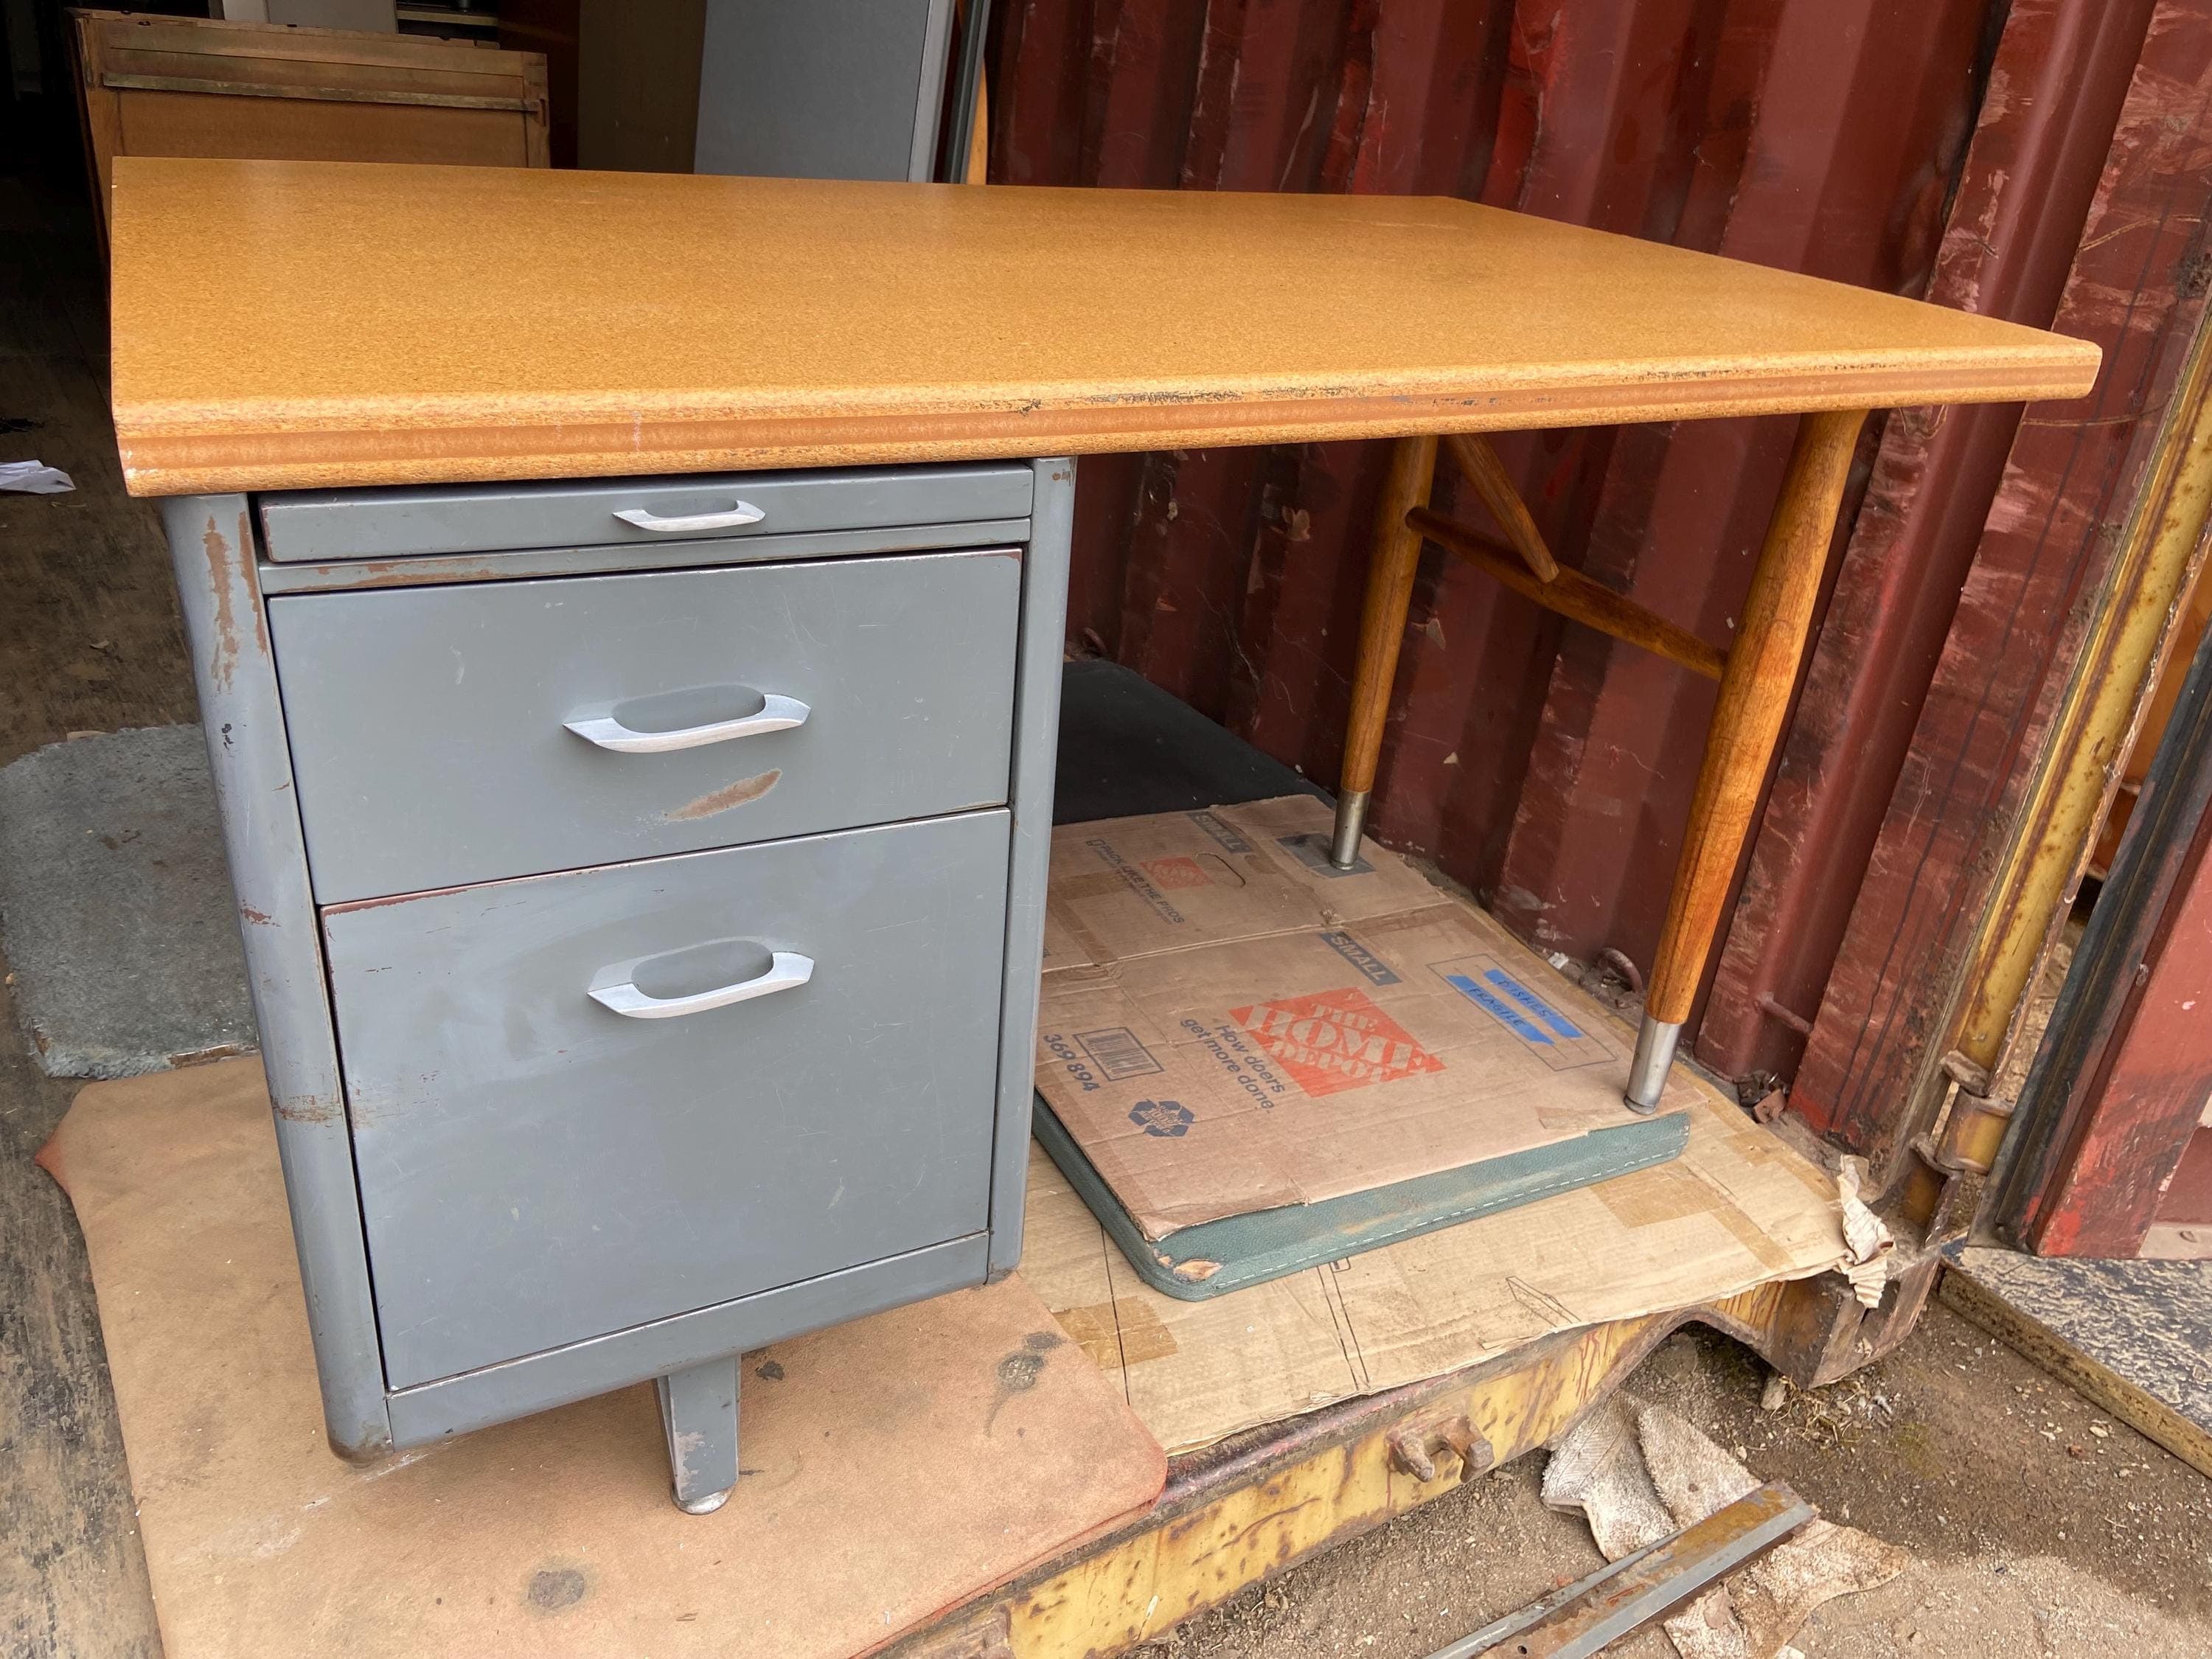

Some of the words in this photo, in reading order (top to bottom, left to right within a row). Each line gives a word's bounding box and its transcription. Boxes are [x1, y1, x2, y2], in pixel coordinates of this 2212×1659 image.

[1099, 845, 1126, 864] PACK
[1121, 866, 1145, 883] LIKE
[1140, 883, 1161, 900] THE
[1156, 901, 1184, 923] PROS
[1330, 936, 1387, 981] SMALL
[1310, 1003, 1377, 1032] THE
[1468, 988, 1525, 1027] FRAGILE
[1498, 980, 1552, 1017] DISHES
[1043, 1034, 1077, 1060] 369
[1066, 1062, 1102, 1091] 894
[1180, 1019, 1212, 1039] get
[1204, 1040, 1241, 1073] more
[1214, 1025, 1248, 1052] How
[1244, 1056, 1285, 1093] doers
[1245, 1005, 1427, 1074] HOME
[1270, 1040, 1392, 1083] DEPOT
